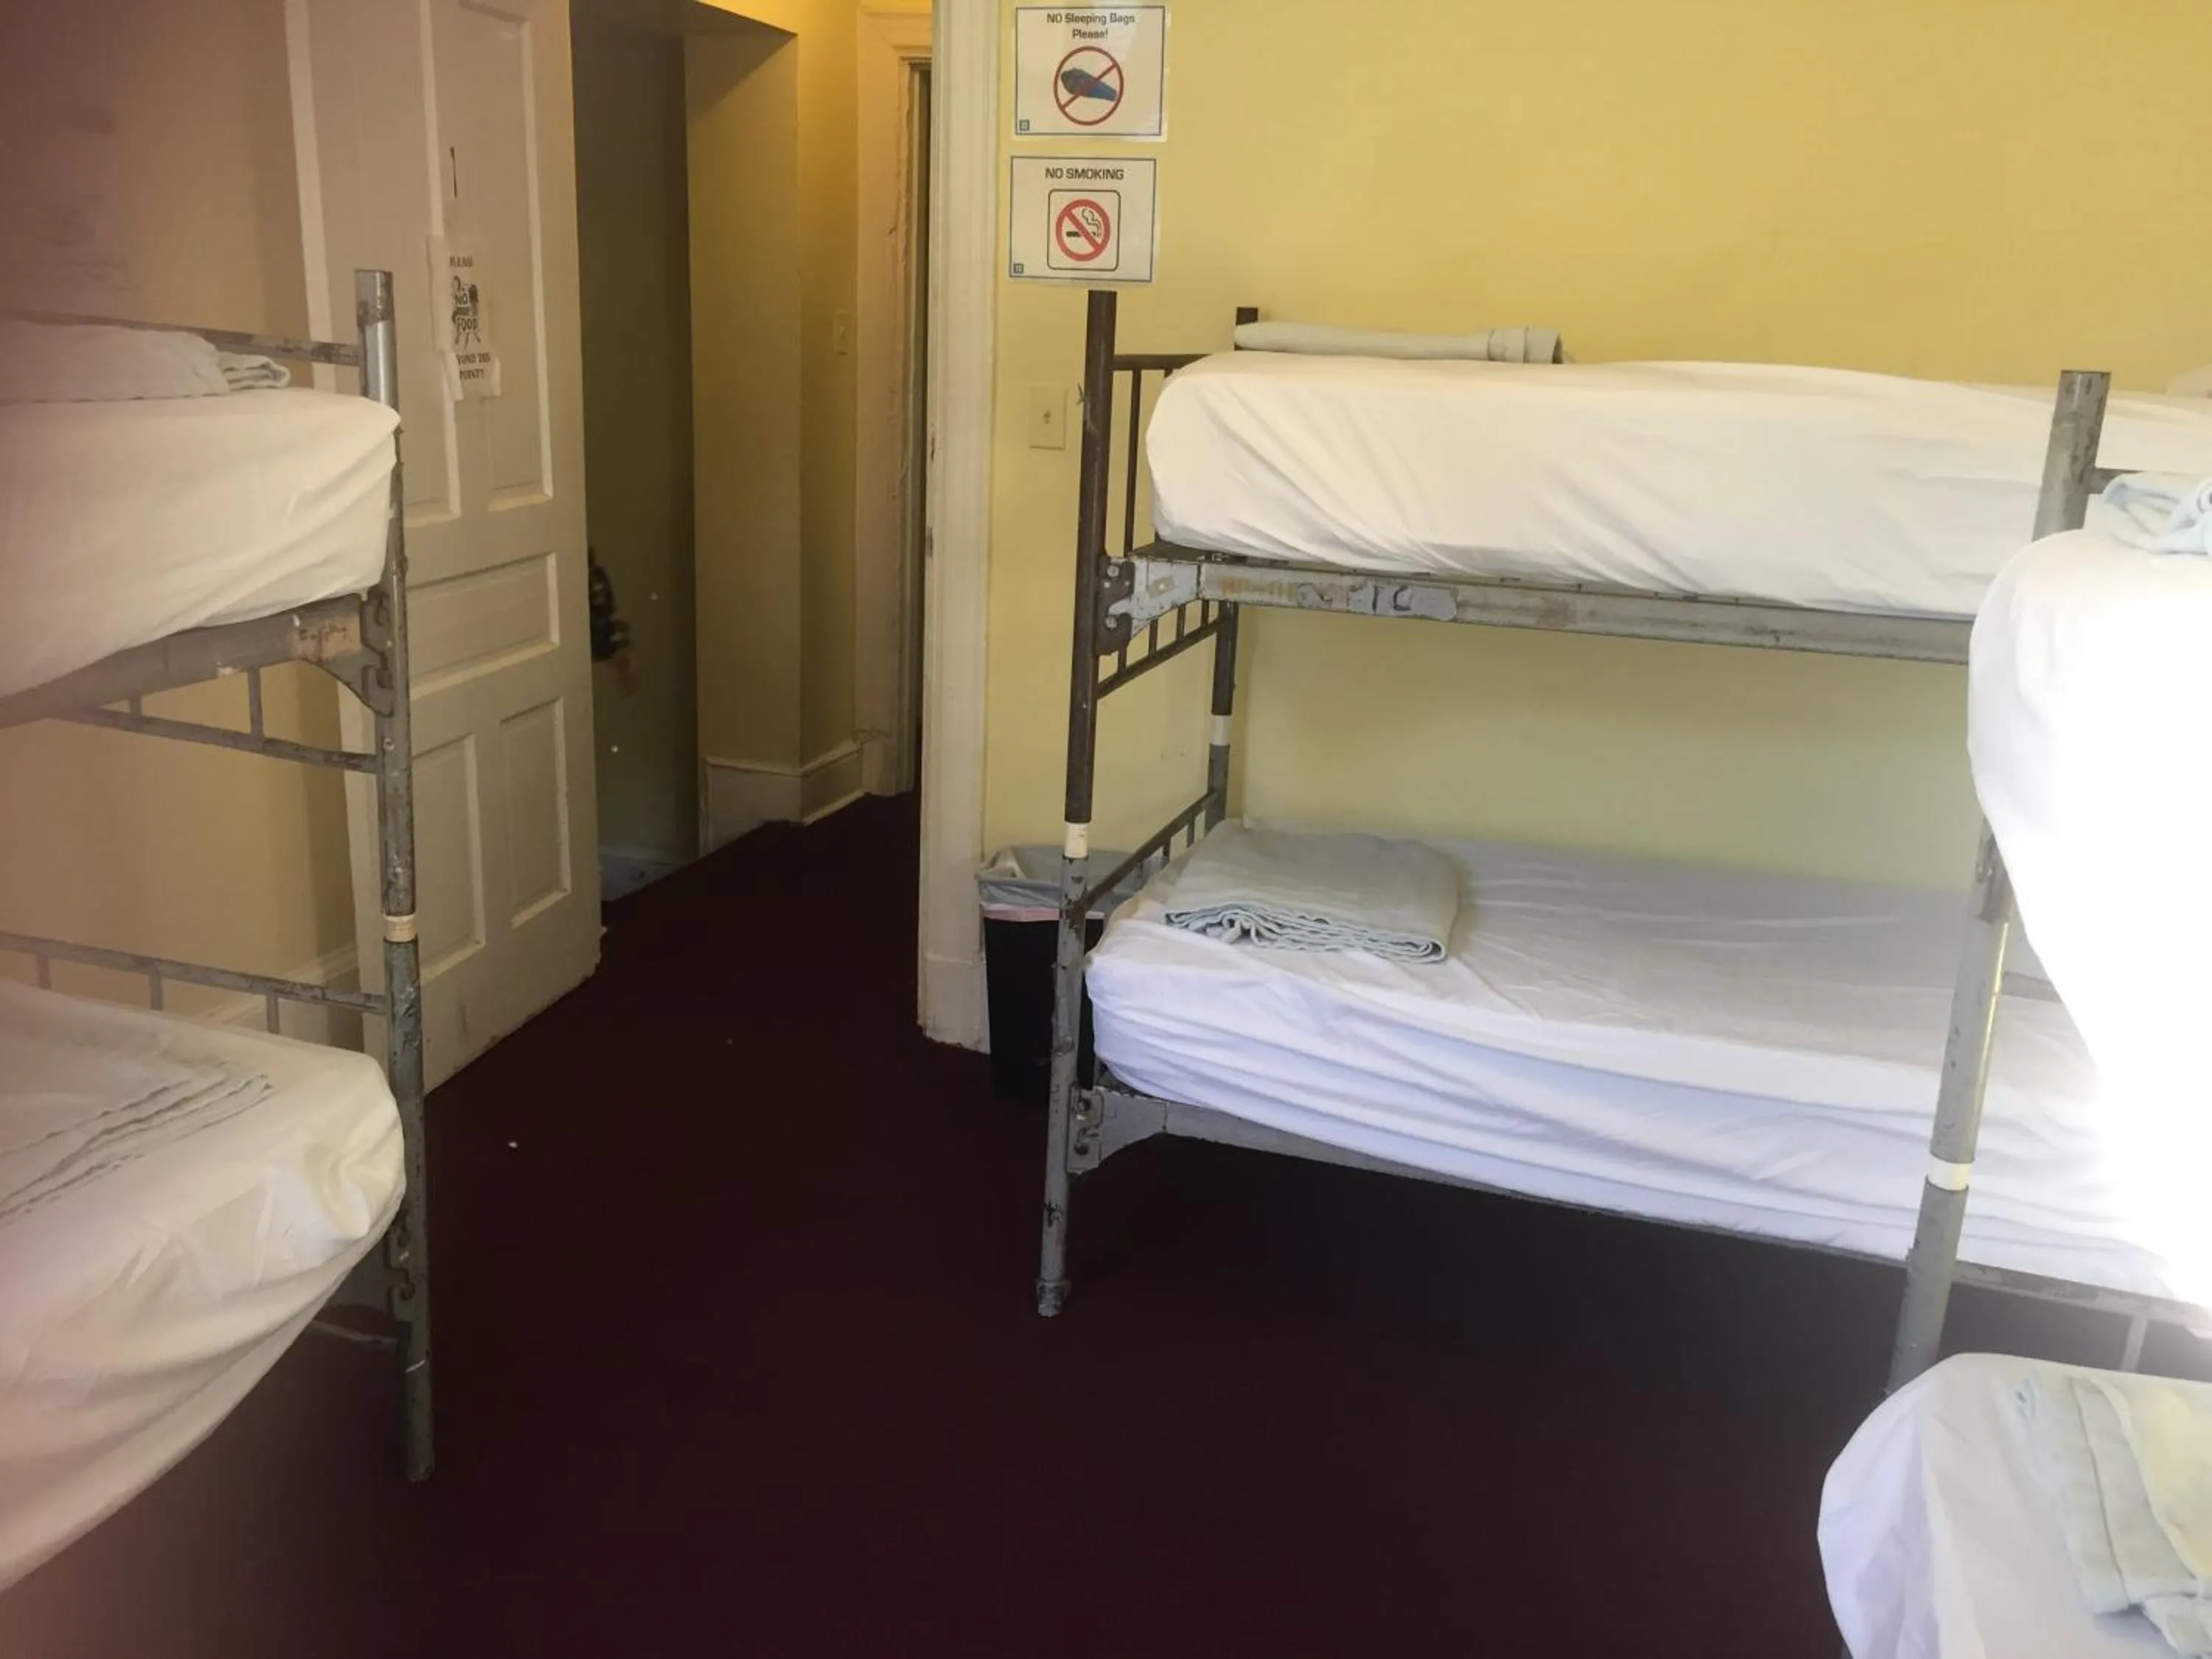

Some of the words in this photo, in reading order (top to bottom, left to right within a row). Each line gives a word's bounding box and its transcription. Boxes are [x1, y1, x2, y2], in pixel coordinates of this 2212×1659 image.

[1046, 13, 1062, 24] NO
[1065, 13, 1107, 25] Sleeping
[1110, 12, 1135, 25] Bags
[1045, 167, 1064, 179] NO
[1065, 167, 1124, 181] SMOKING
[454, 293, 468, 305] NO
[456, 318, 478, 331] FOOD
